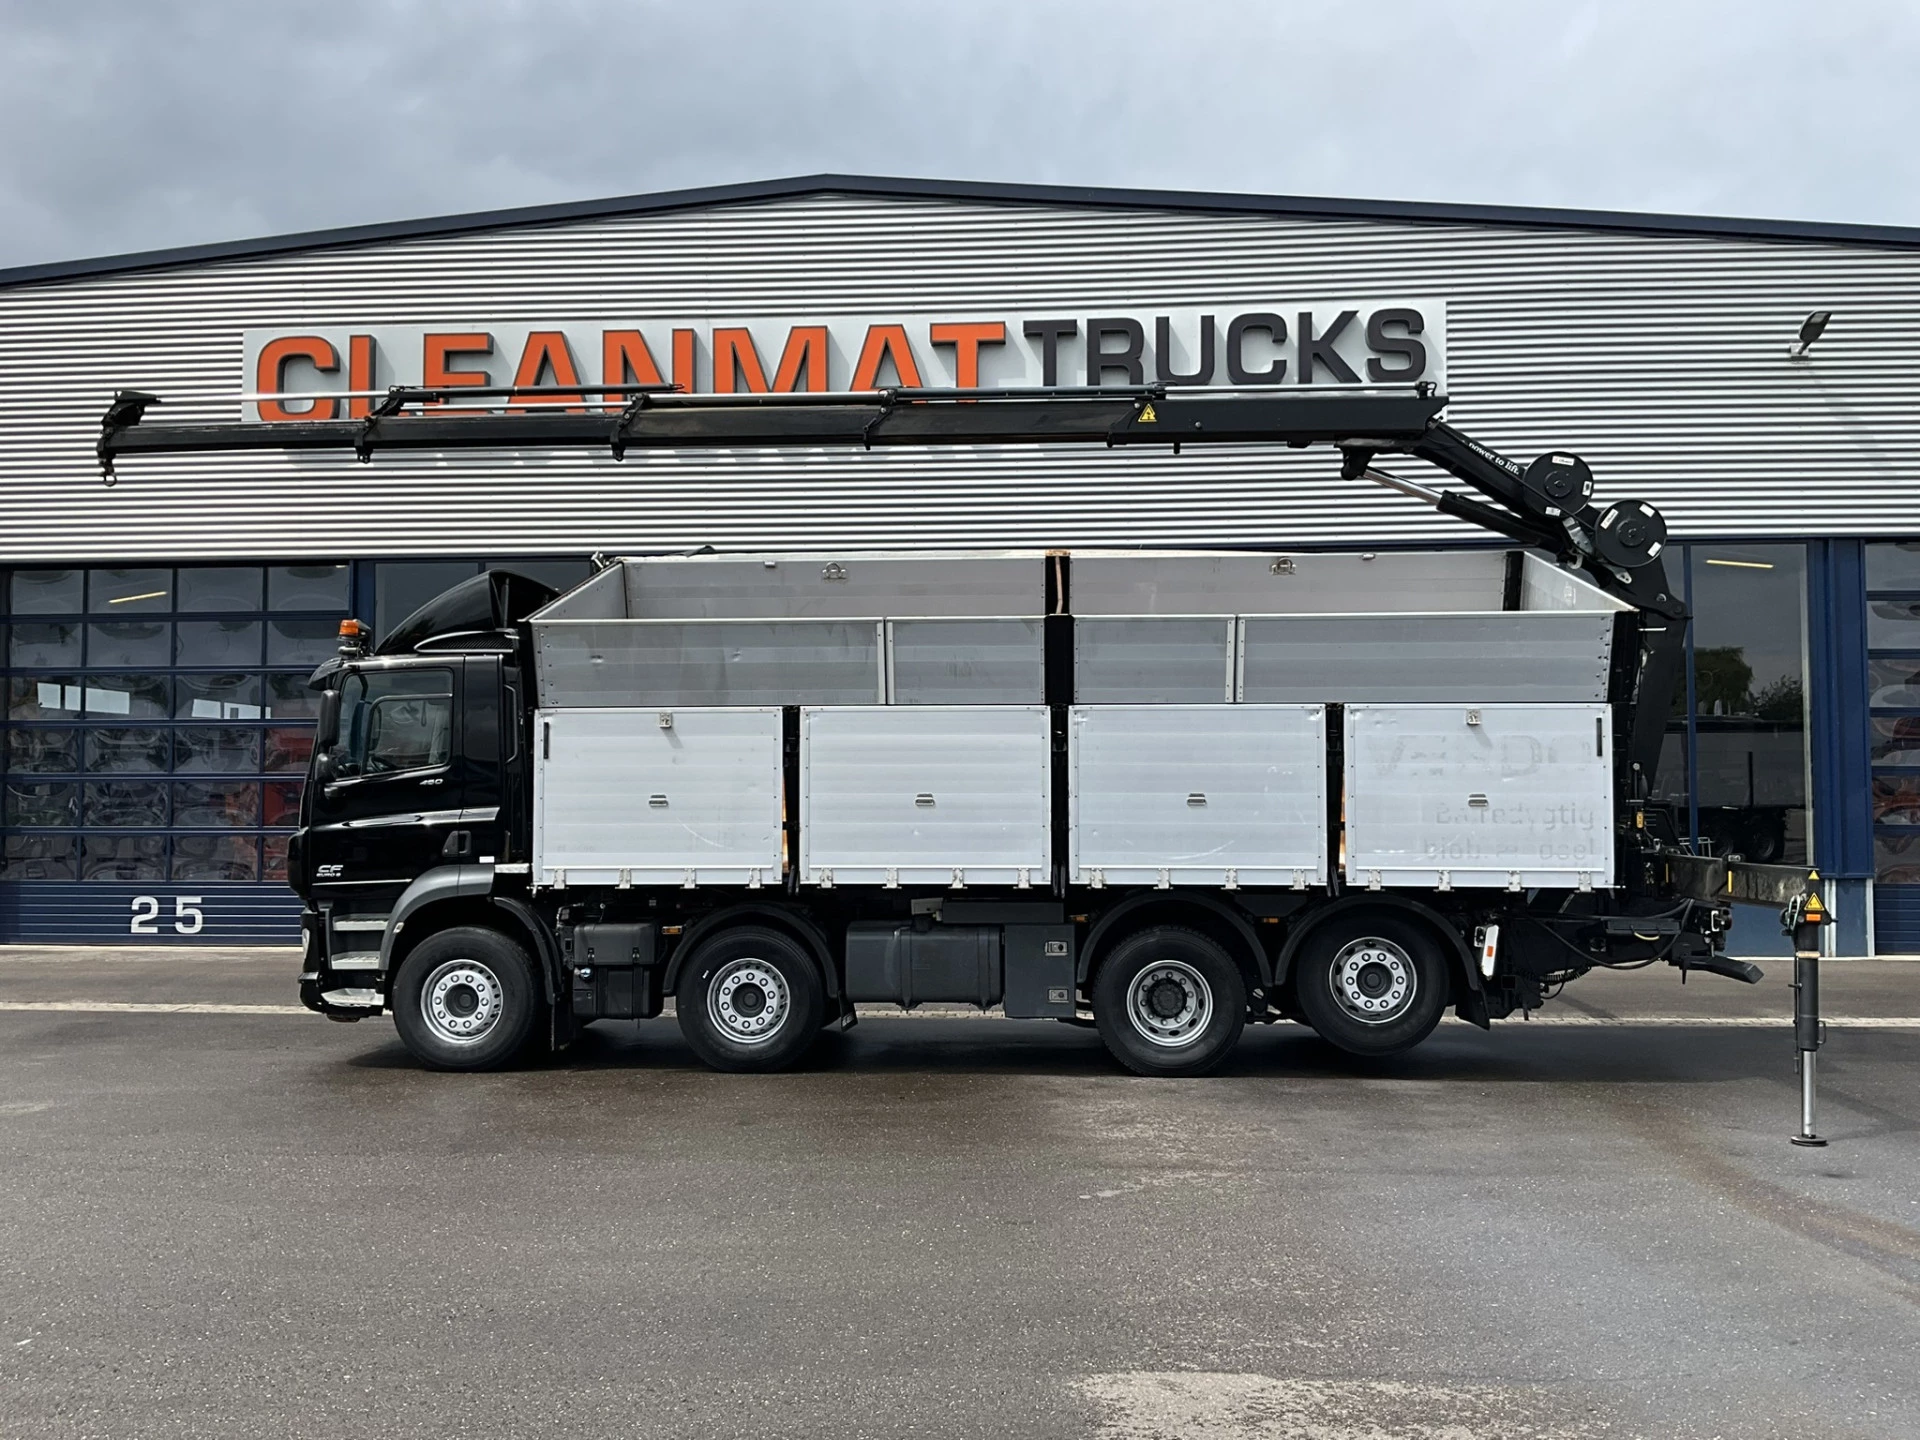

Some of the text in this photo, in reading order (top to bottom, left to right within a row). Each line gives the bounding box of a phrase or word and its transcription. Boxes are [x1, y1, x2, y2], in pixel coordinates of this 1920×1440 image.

[256, 308, 1427, 421] CLEANMAT TRUCKS
[1495, 457, 1505, 466] to
[318, 864, 344, 873] CF
